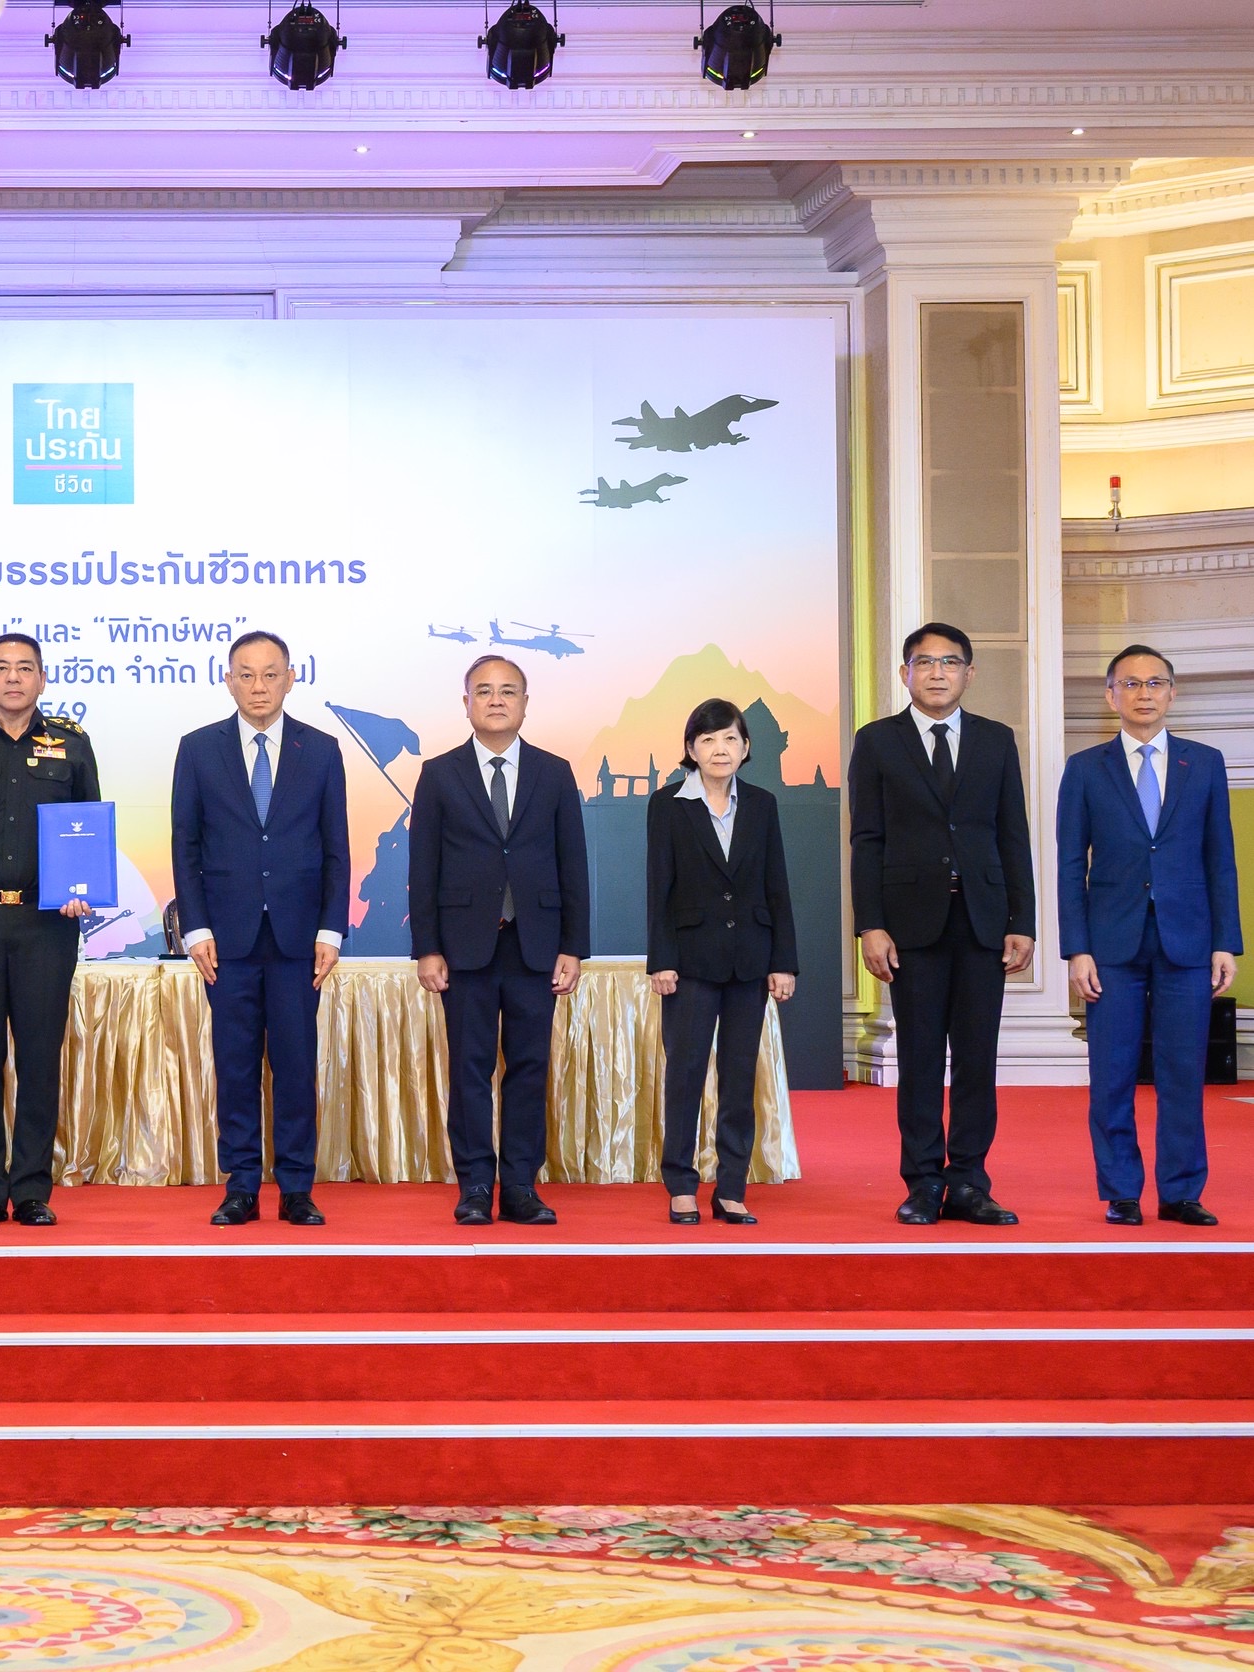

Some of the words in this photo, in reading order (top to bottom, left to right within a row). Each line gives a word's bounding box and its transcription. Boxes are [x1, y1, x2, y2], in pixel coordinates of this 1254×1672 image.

[34, 398, 101, 430] ไทย
[26, 431, 122, 460] ประกัน
[55, 474, 93, 493] ชีวิต
[35, 624, 81, 643] และ
[93, 616, 247, 643] “พิทักษ์พล”
[126, 655, 196, 684] จำกัด
[39, 701, 87, 725] 569
